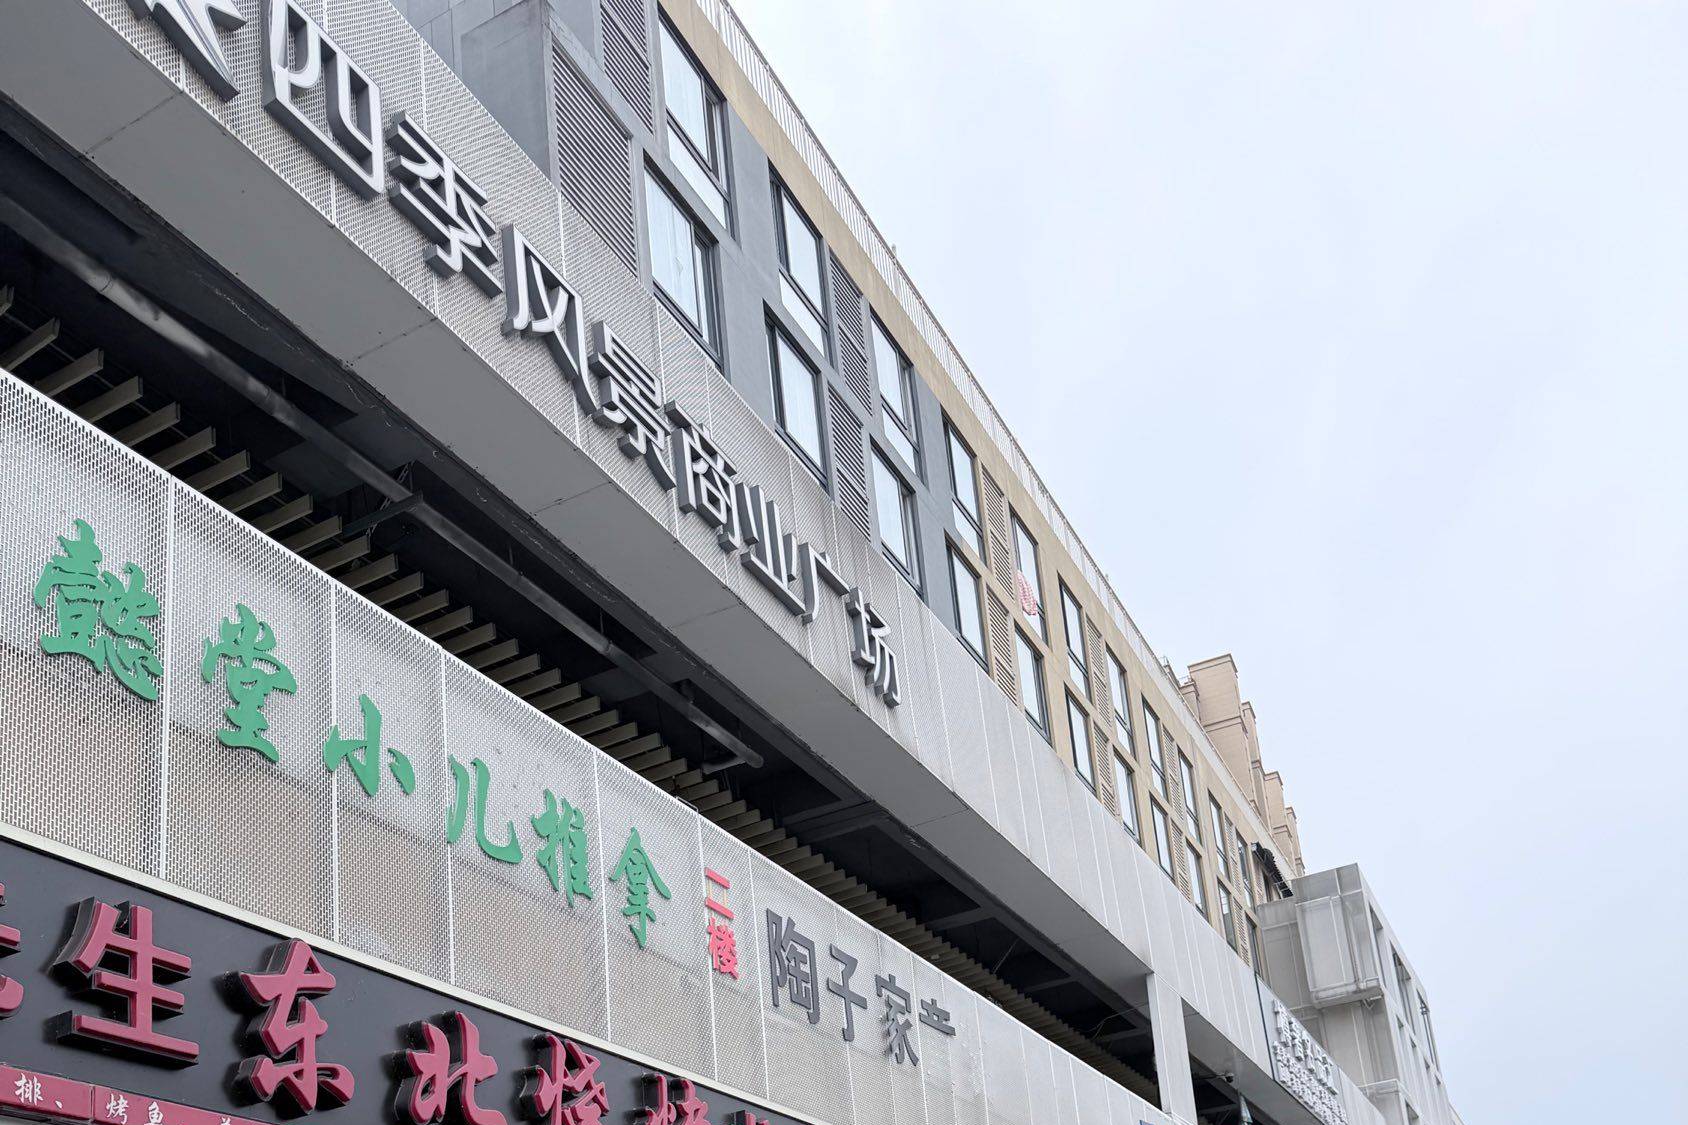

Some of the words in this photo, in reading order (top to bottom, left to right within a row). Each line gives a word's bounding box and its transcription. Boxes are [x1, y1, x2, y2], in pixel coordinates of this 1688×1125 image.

[34, 518, 672, 949] 懿堂小儿推拿
[705, 867, 738, 980] 二楼
